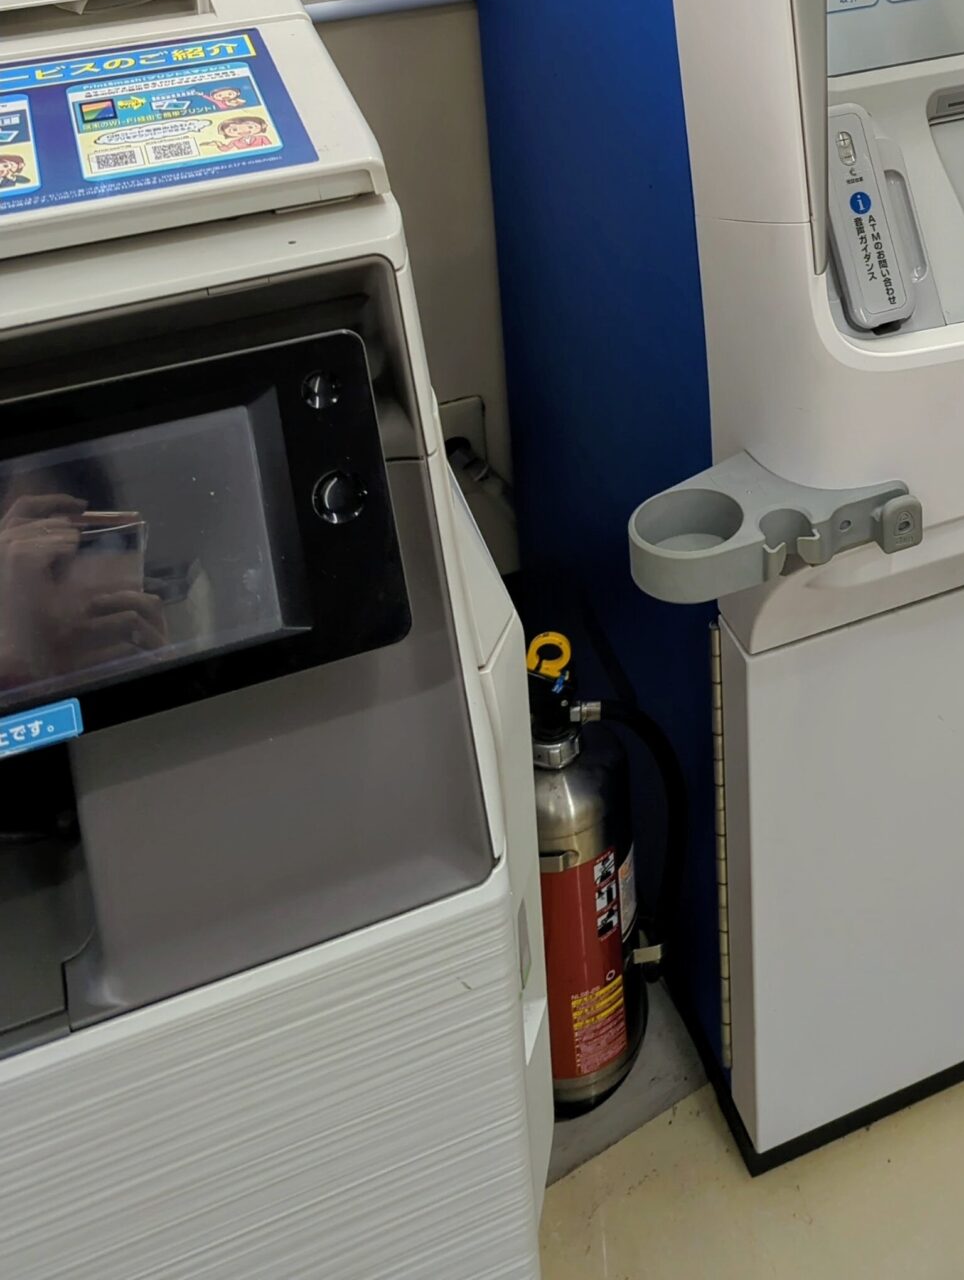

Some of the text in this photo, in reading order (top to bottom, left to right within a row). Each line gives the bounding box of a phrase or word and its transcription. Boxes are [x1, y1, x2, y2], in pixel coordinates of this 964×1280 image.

[853, 217, 877, 281] 音声ガイダンス
[868, 214, 896, 305] ATMのお問い合わせ
